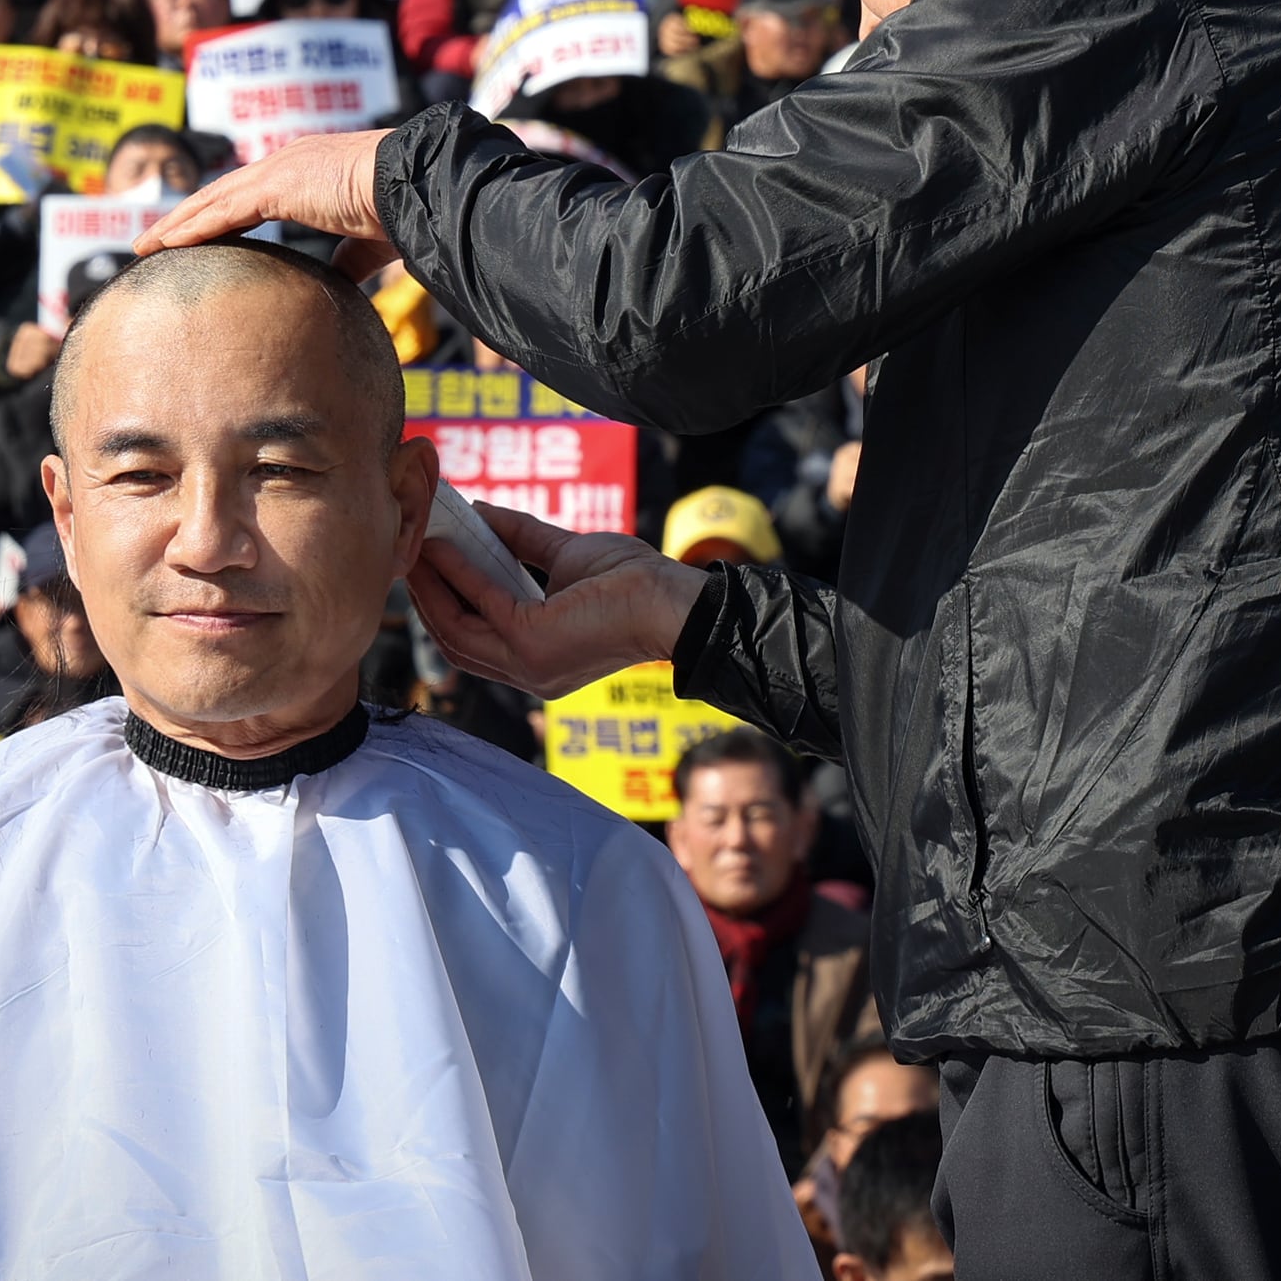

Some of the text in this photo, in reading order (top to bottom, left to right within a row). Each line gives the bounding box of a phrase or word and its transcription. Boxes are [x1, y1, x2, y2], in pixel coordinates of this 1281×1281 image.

[230, 80, 362, 123] 강원특별법
[55, 208, 131, 239] 이름만
[404, 369, 519, 418] 통합엔
[434, 424, 584, 483] 강원은
[557, 716, 660, 759] 강특법
